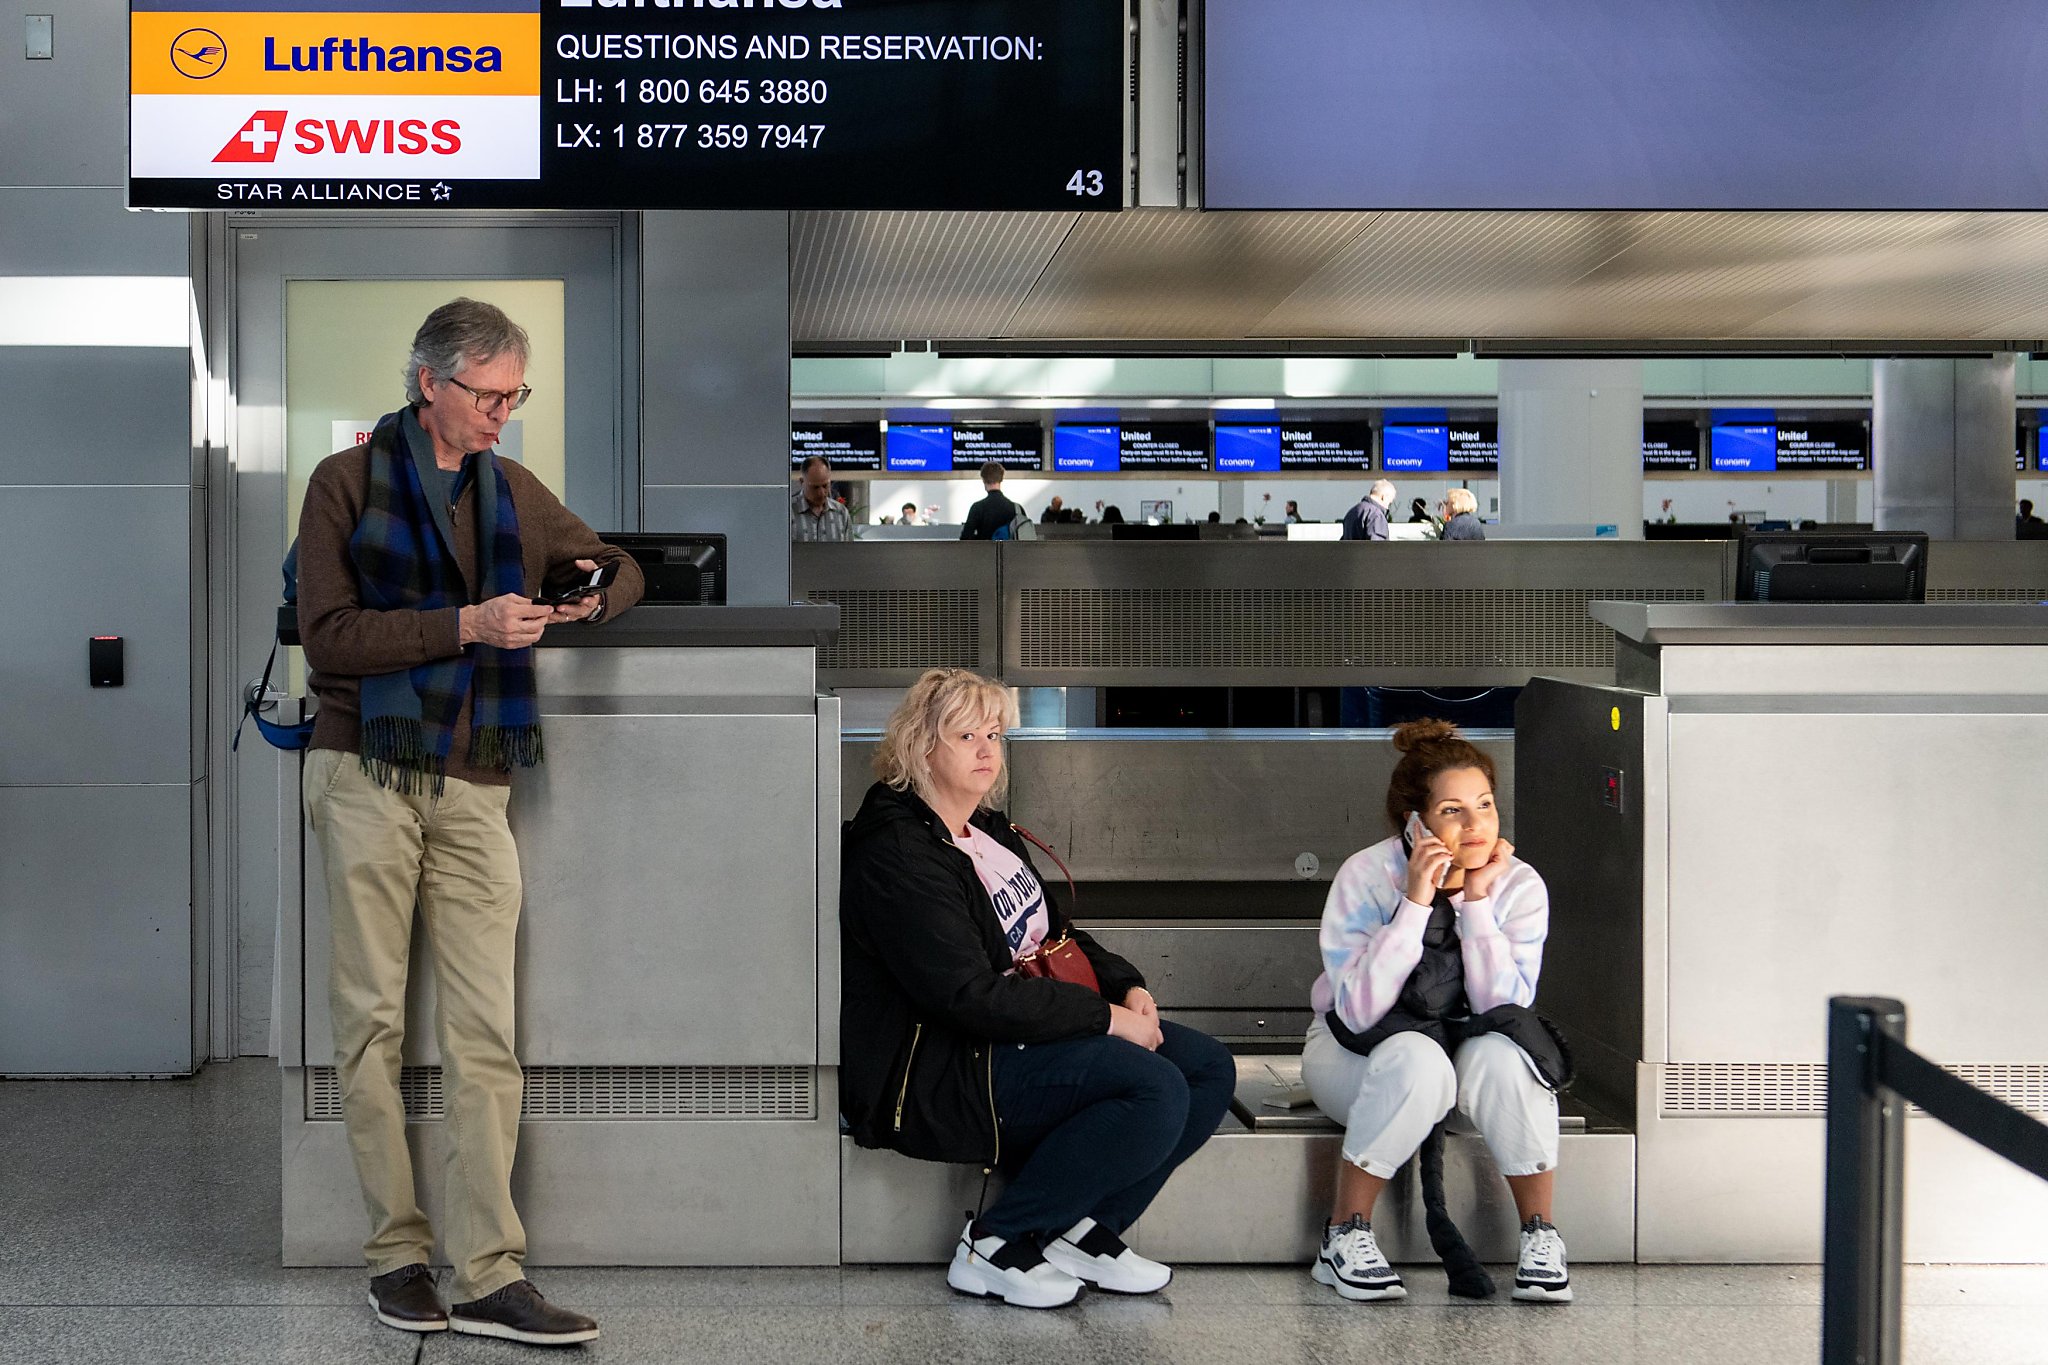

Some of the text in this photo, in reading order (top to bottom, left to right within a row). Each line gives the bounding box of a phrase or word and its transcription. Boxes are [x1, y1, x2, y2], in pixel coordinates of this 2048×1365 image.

[557, 34, 1043, 61] QUESTIONS AND RESERVATION:
[264, 37, 502, 73] Lufthansa
[557, 79, 828, 104] LH: 1 800 645 3880
[294, 119, 462, 155] SWISS
[557, 124, 826, 149] LX: 1 877 359 7947
[1066, 170, 1104, 197] 43
[217, 183, 421, 200] STAR ALLIANCE
[792, 431, 823, 441] United
[953, 431, 984, 441] United
[1121, 431, 1151, 441] United
[1282, 431, 1312, 441] United
[1450, 431, 1480, 441] United
[1777, 431, 1808, 441] United
[891, 458, 927, 467] Economy
[1059, 458, 1094, 467] Economy
[1220, 458, 1255, 467] Economy
[1387, 458, 1422, 467] Economy
[1716, 458, 1751, 467] Economy
[1010, 926, 1023, 944] CA
